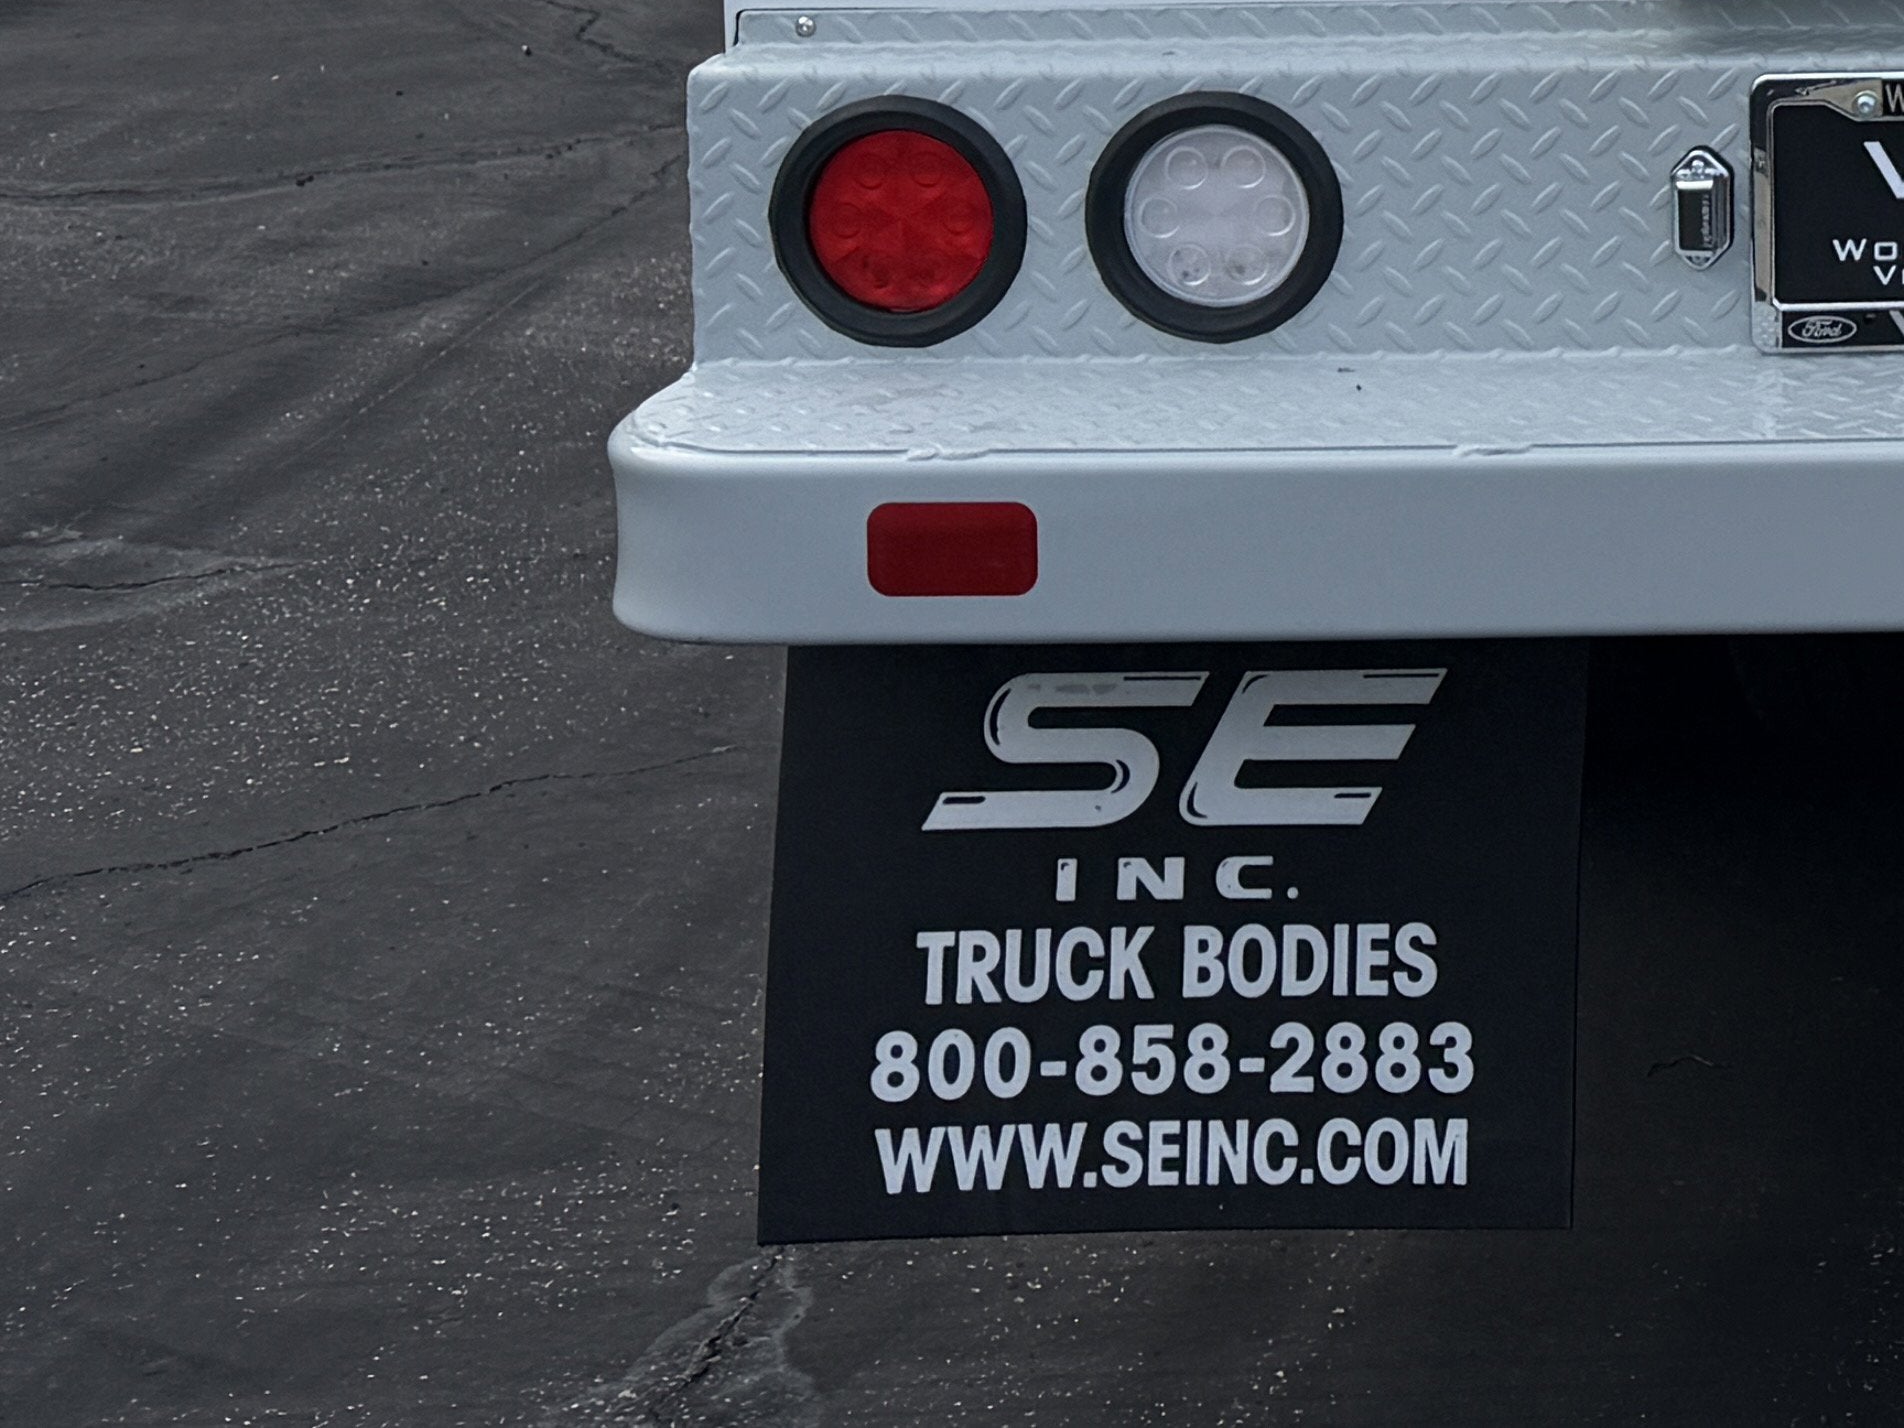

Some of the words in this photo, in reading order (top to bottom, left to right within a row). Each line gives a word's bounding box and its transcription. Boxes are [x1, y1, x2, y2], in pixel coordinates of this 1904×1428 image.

[1802, 318, 1843, 338] Ford
[921, 668, 1448, 832] SE
[1054, 856, 1300, 902] INC.
[916, 924, 1154, 1006] TRUCK
[1181, 922, 1438, 999] BODIES
[870, 1020, 1475, 1103] 800-858-2883
[875, 1117, 1468, 1195] WWW.SEINC.COM
